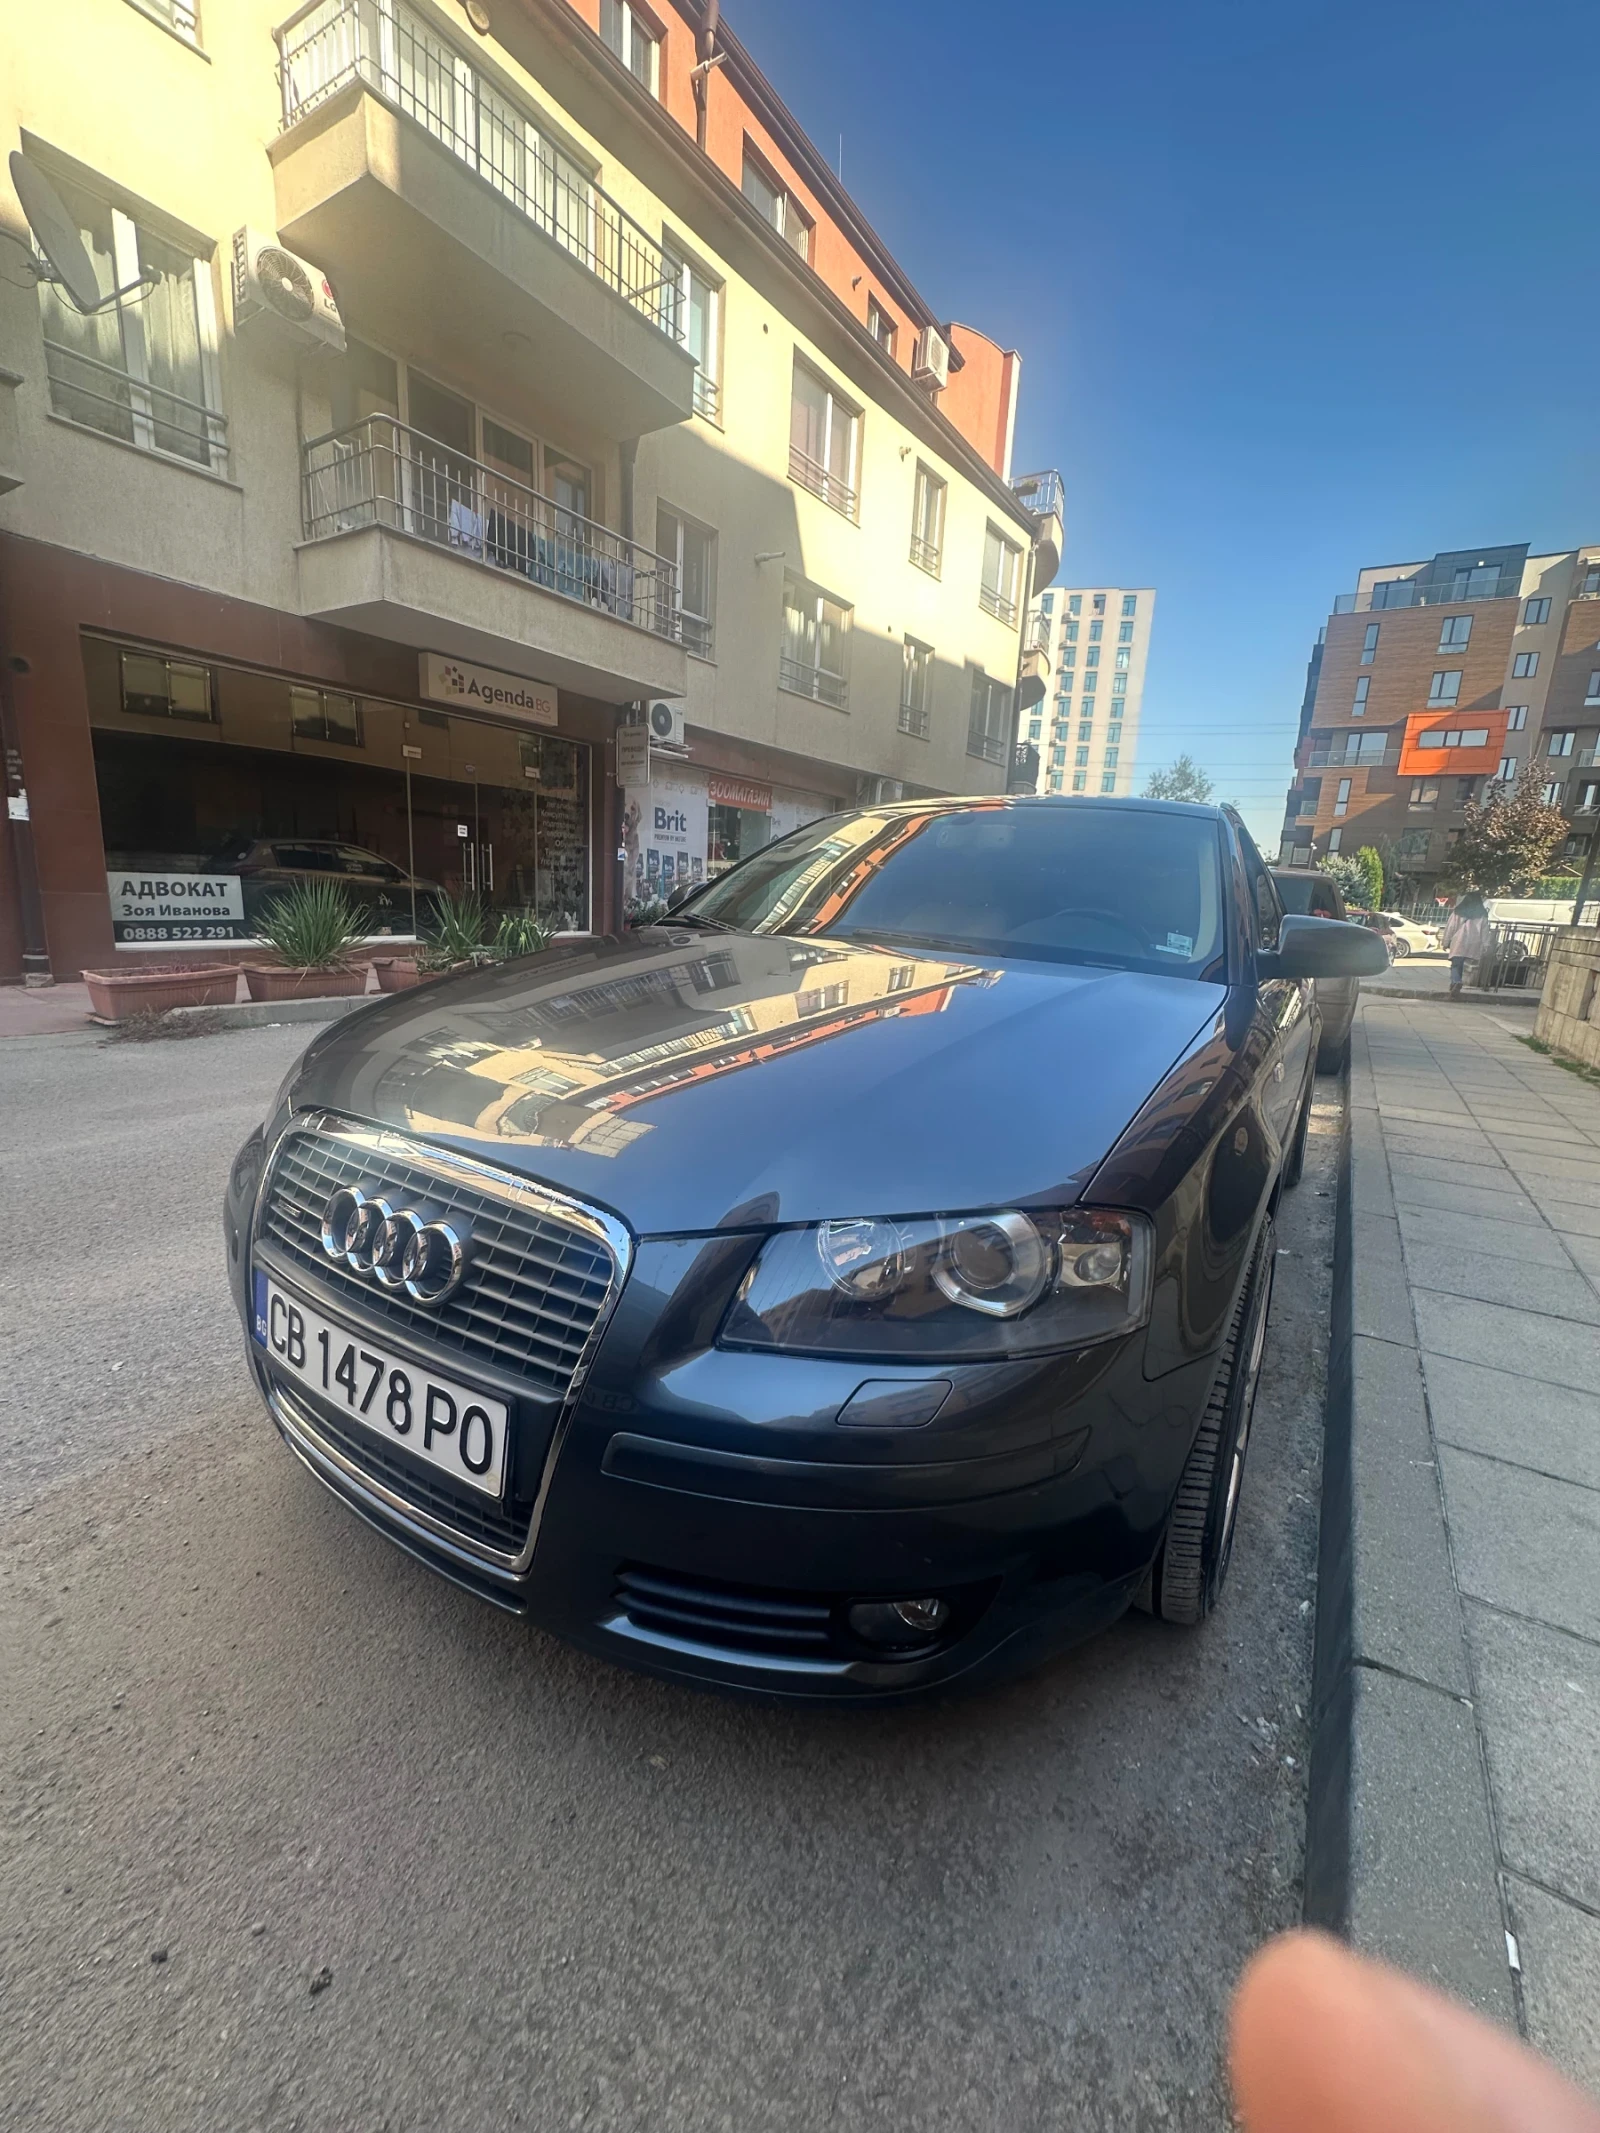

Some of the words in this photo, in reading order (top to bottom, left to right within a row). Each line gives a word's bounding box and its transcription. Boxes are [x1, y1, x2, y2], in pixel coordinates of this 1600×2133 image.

[710, 781, 771, 807] ЗООМАГАЗИН
[655, 806, 687, 832] Brit
[121, 880, 228, 900] АДВОКАТ
[122, 904, 156, 917] Зоя
[159, 904, 231, 917] Иванова
[123, 927, 169, 940] 0888
[172, 927, 203, 939] 522
[206, 926, 234, 938] 291
[256, 1314, 268, 1337] BG
[270, 1293, 306, 1369] CB
[318, 1326, 412, 1436] 1478
